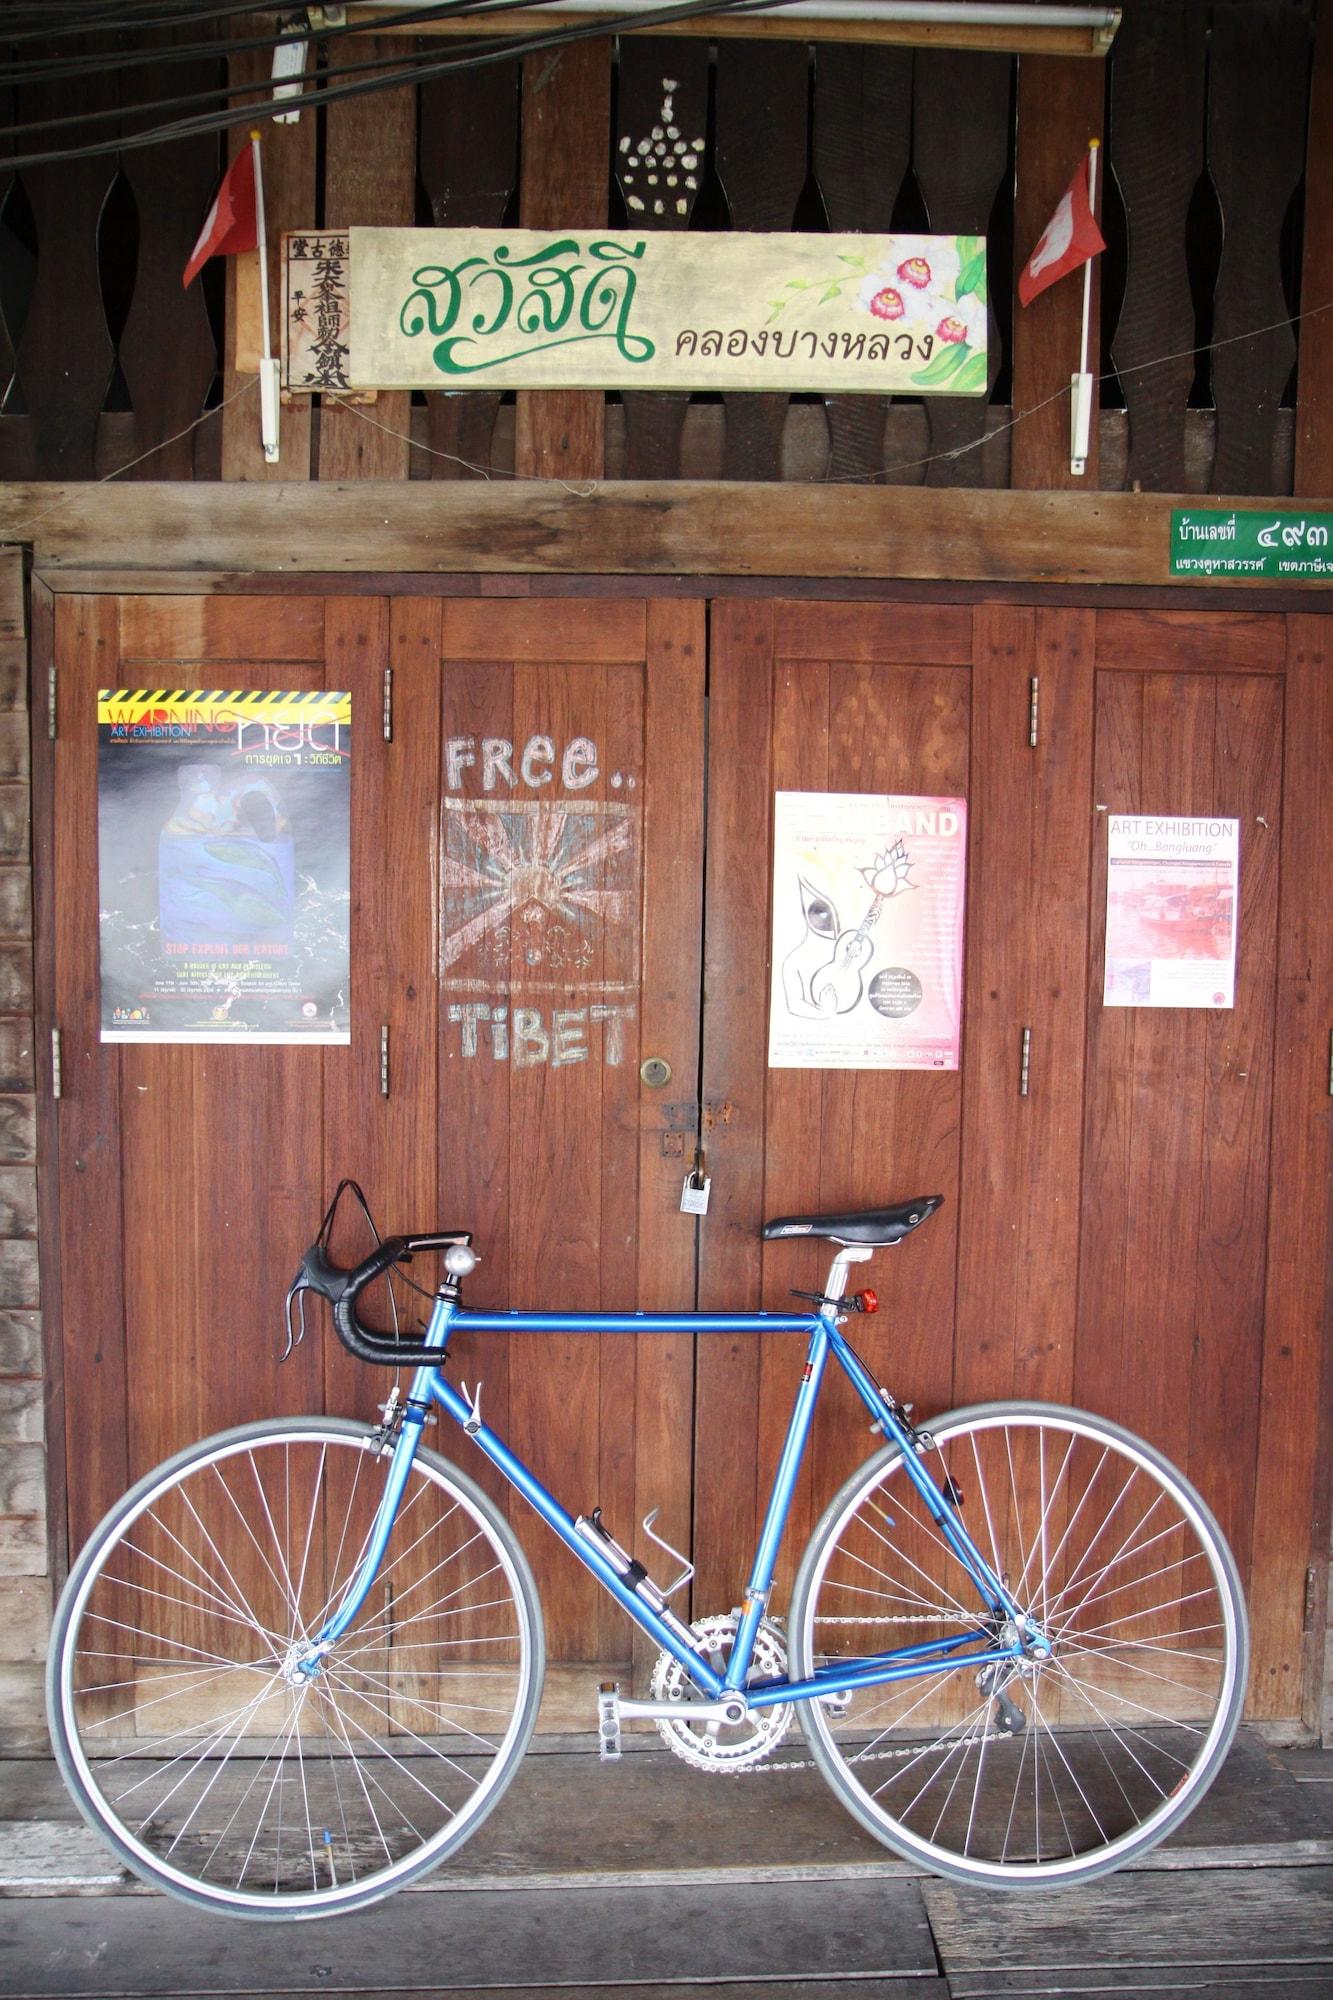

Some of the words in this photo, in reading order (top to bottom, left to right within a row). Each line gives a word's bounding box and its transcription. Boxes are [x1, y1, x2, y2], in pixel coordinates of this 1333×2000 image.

[399, 239, 656, 375] สวัสดี
[675, 329, 935, 361] คลองบางหลวง
[1178, 513, 1236, 541] บ้านเลขที่
[1256, 520, 1329, 548] ๔๙๓
[1175, 556, 1267, 575] แขวงคูหาสวรรค์
[107, 708, 239, 733] WARNING
[110, 726, 129, 737] ART
[133, 726, 191, 737] EXHIBITION
[1110, 820, 1141, 835] ART
[1146, 821, 1233, 837] EXHIBITION
